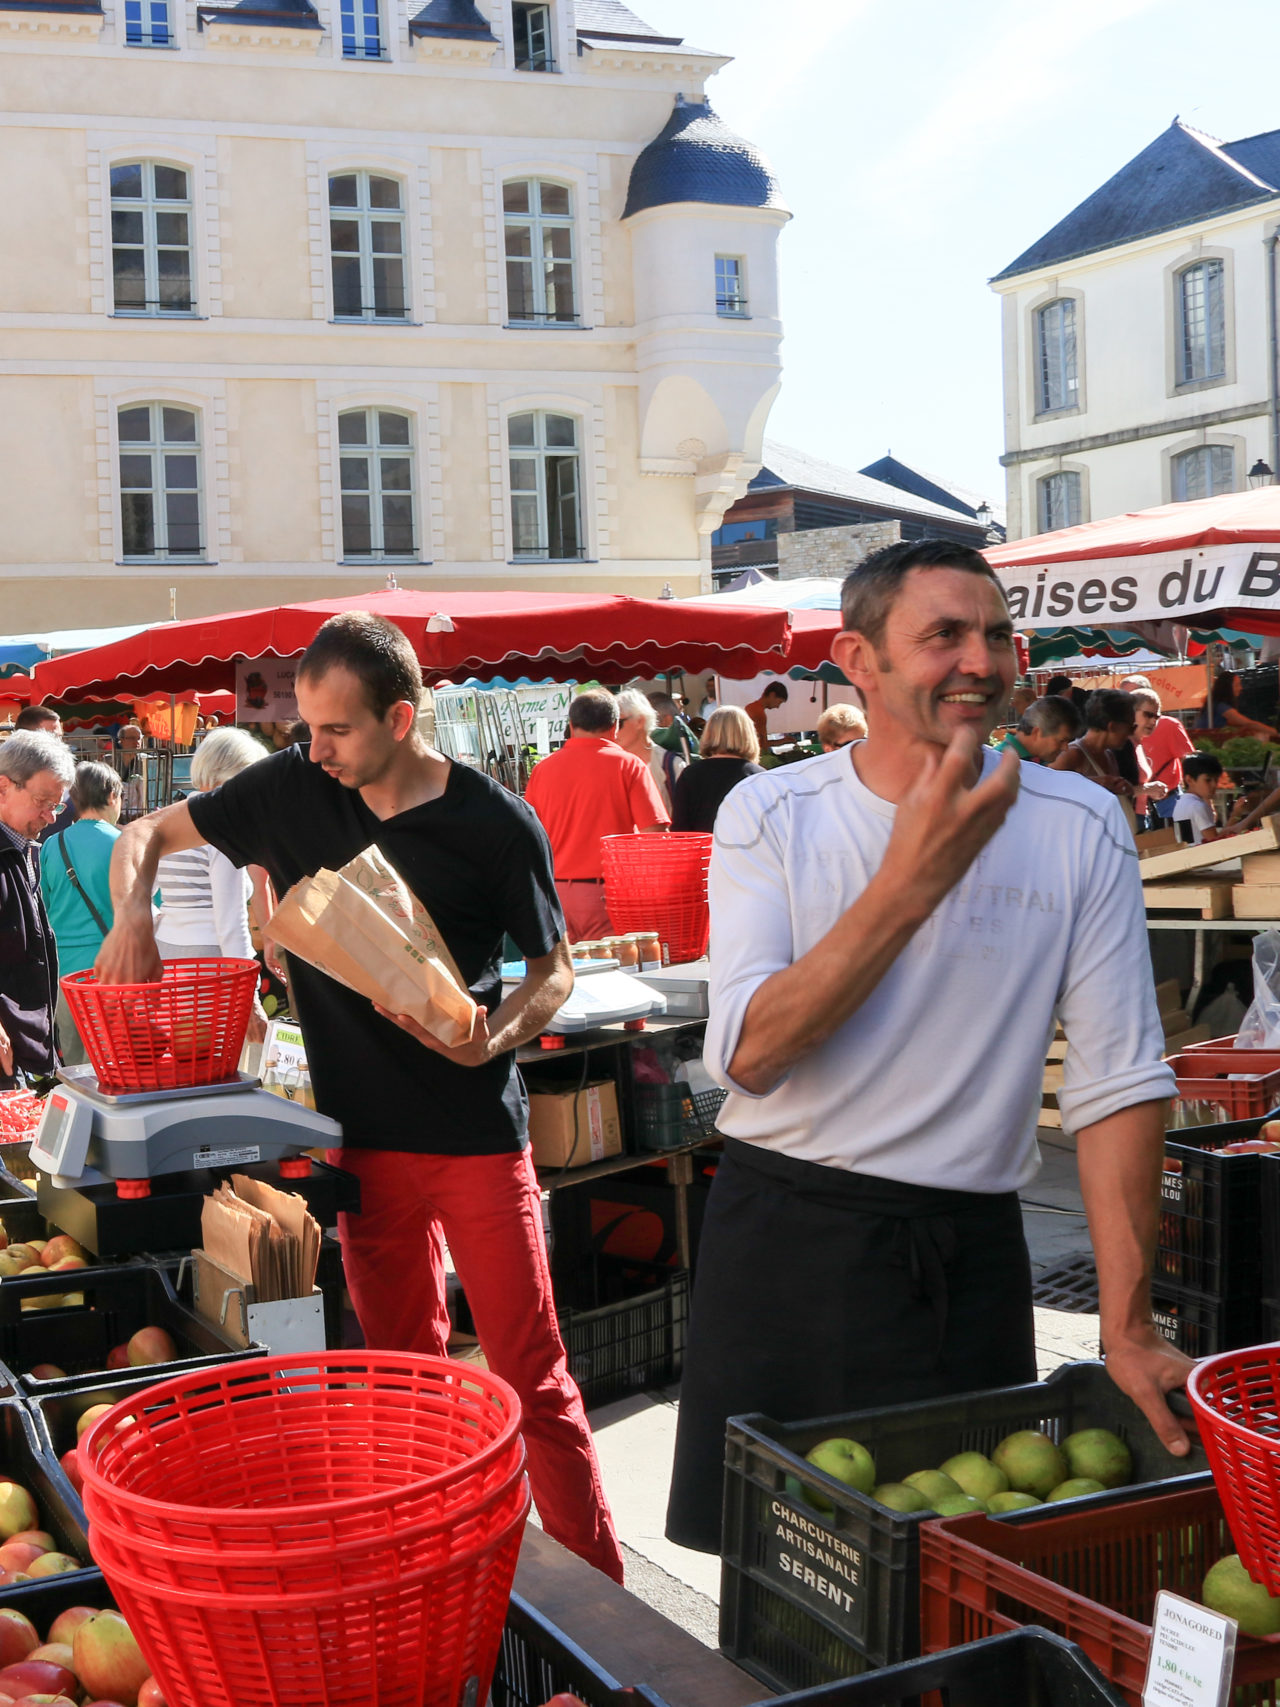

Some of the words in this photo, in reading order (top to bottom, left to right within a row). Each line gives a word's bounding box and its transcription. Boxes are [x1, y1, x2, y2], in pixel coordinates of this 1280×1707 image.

[1004, 571, 1138, 619] aises
[1158, 558, 1225, 608] du
[771, 1501, 861, 1566] CHARCUTERIE
[775, 1523, 859, 1586] ARTISANALE
[778, 1552, 855, 1613] SERENT
[1163, 1608, 1223, 1641] JONAGORED
